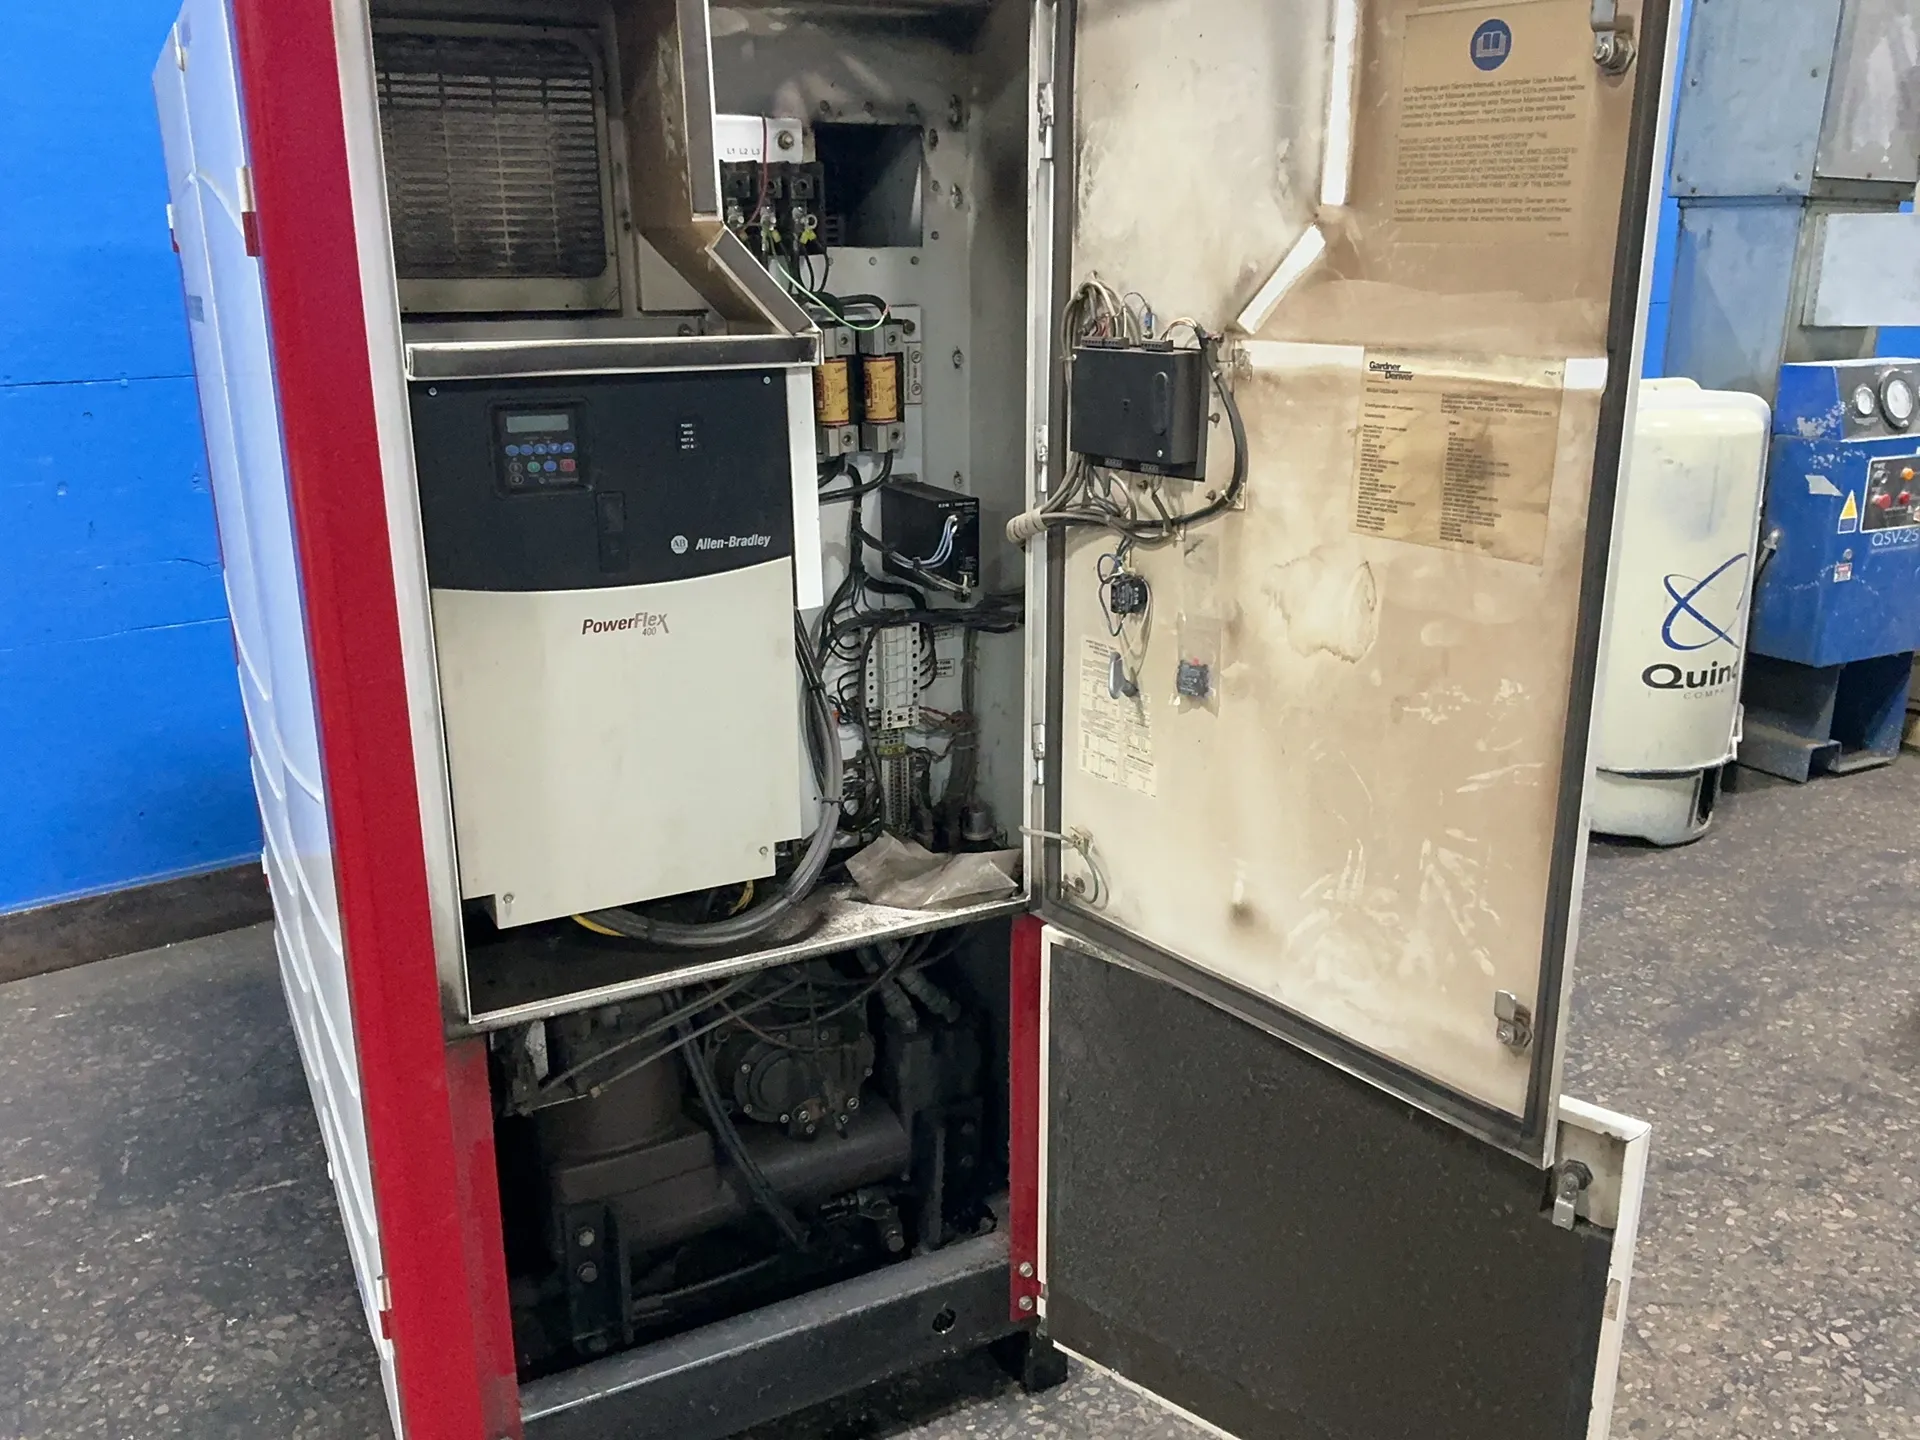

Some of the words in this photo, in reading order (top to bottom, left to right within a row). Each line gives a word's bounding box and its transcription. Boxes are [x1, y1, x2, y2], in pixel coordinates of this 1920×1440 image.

[1369, 360, 1401, 371] Gardner
[1384, 370, 1414, 381] Denver
[696, 534, 771, 550] Allen-Bradley
[582, 612, 669, 635] PowerFlex
[642, 627, 656, 636] 400
